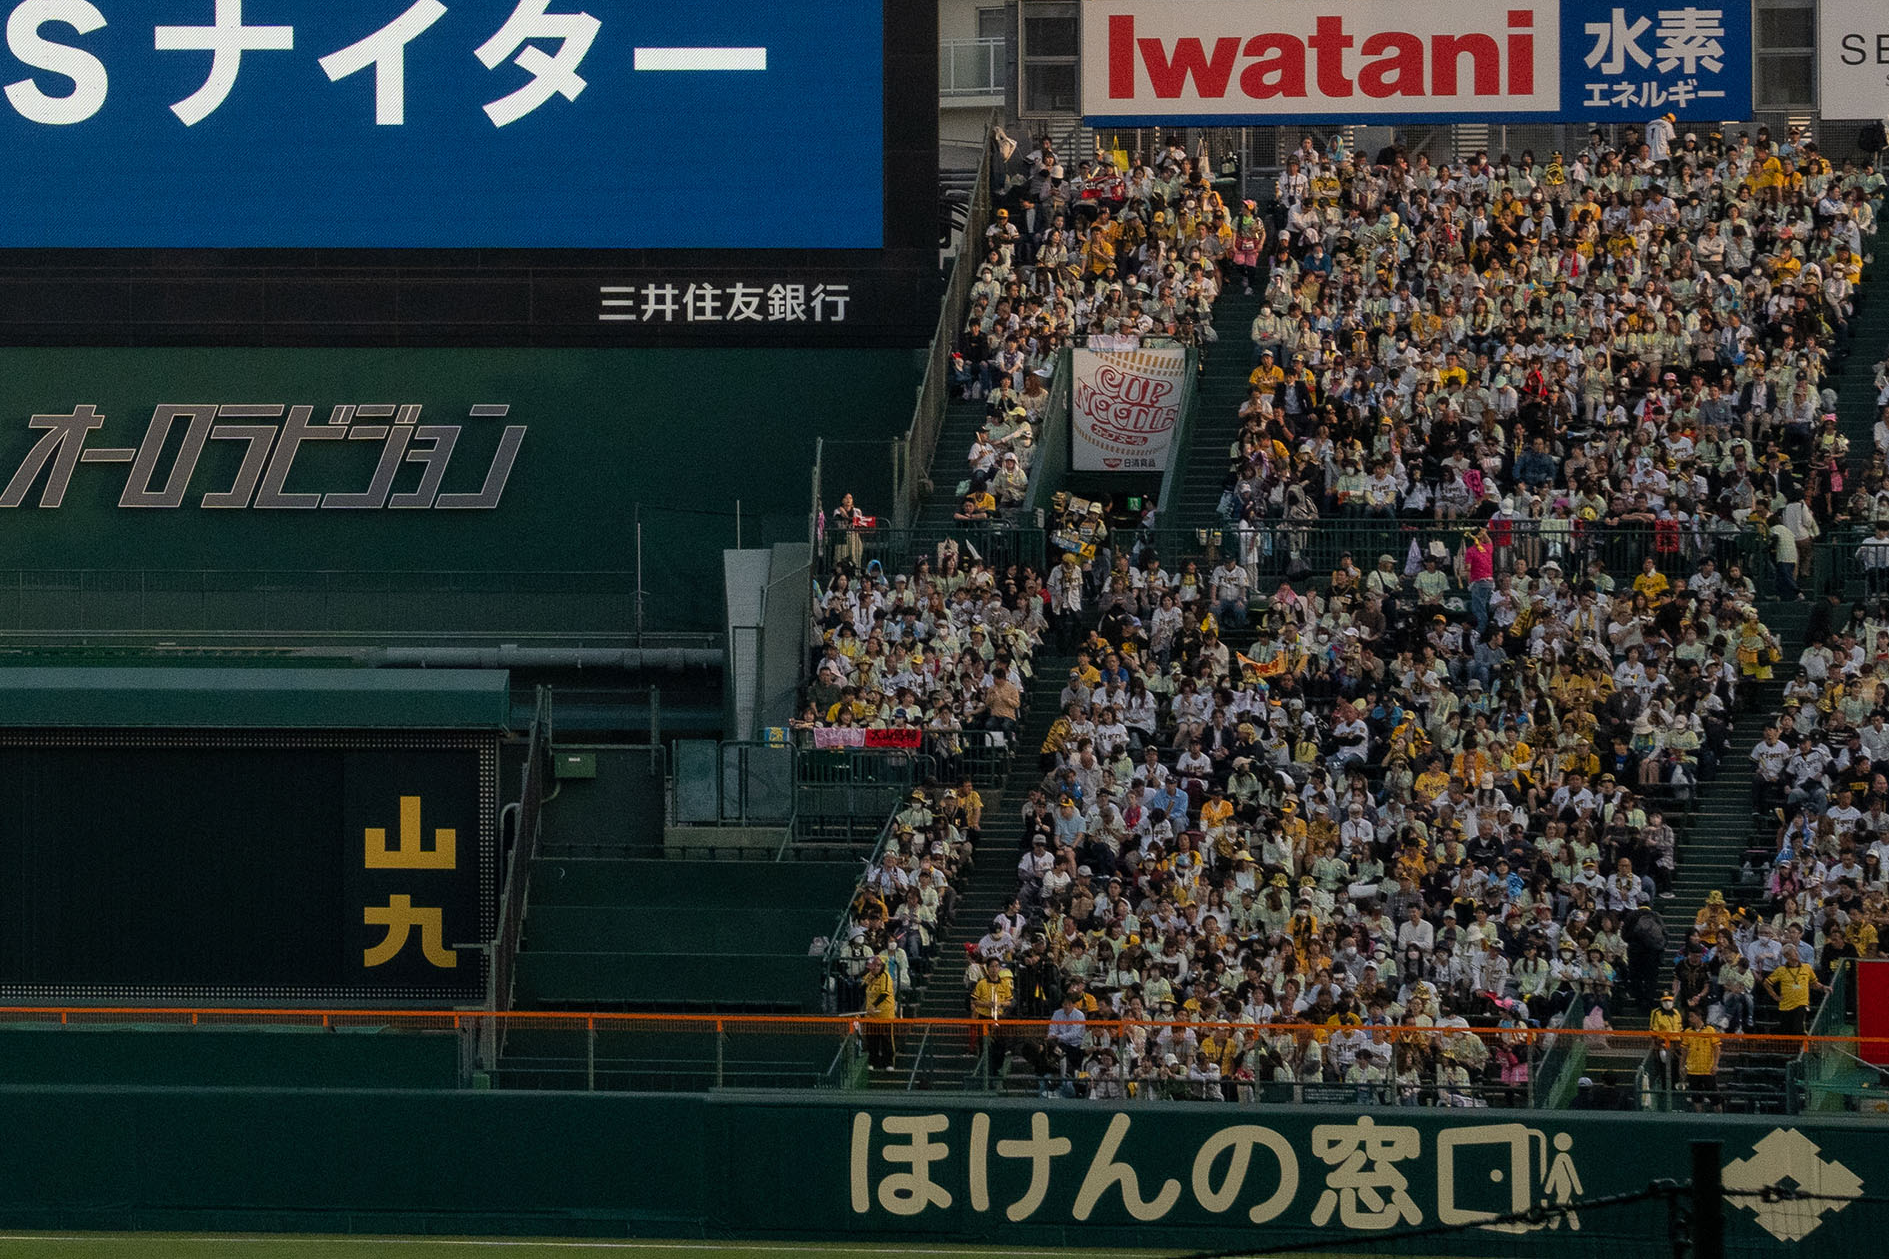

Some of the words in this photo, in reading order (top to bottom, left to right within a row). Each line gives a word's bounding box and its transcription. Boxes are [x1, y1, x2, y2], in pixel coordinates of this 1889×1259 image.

[1107, 9, 1535, 101] Iwatani
[1583, 6, 1725, 75] 水素
[1583, 78, 1726, 109] エネルギー
[598, 282, 852, 322] 三井住友銀行
[1095, 365, 1173, 407] CUP
[362, 794, 459, 969] 山九
[849, 1110, 1546, 1233] ほけんの窓口
